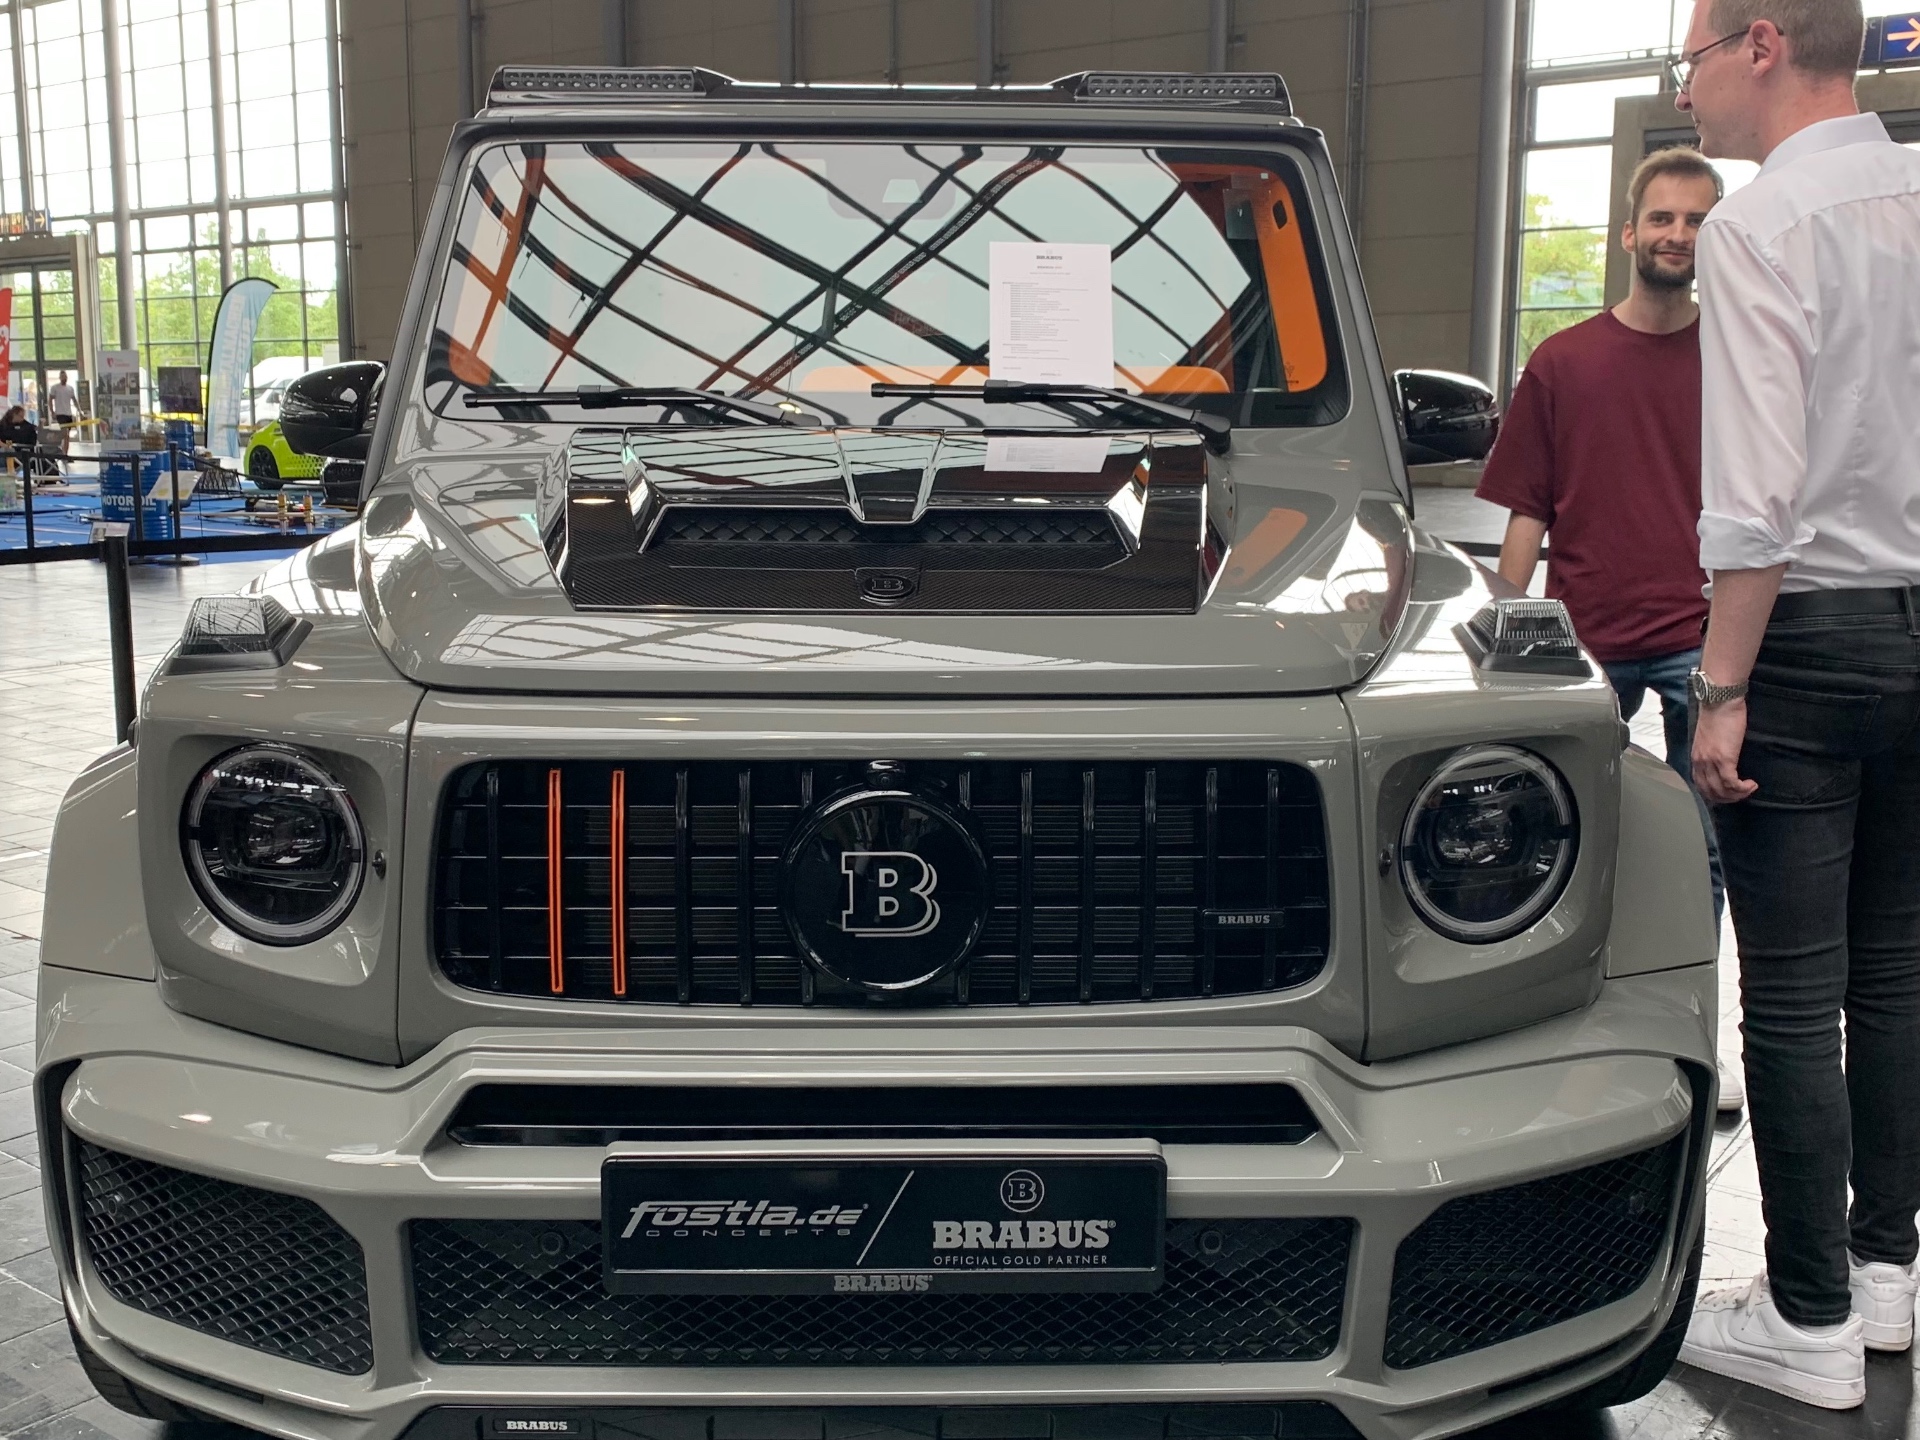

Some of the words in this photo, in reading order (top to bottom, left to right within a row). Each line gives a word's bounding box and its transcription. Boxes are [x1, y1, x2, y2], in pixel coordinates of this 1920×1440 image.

[841, 851, 941, 938] B
[1218, 915, 1270, 924] BRABUS
[1008, 1178, 1037, 1204] B
[621, 1200, 863, 1238] fostla.de
[646, 1229, 851, 1237] CONCEPTS
[932, 1220, 1110, 1249] BRABUS
[933, 1256, 997, 1265] OFFICIAL
[1002, 1256, 1041, 1265] GOLD
[1047, 1255, 1107, 1265] PARTNER
[834, 1275, 930, 1291] BRABUS
[506, 1421, 567, 1430] BRABUS
